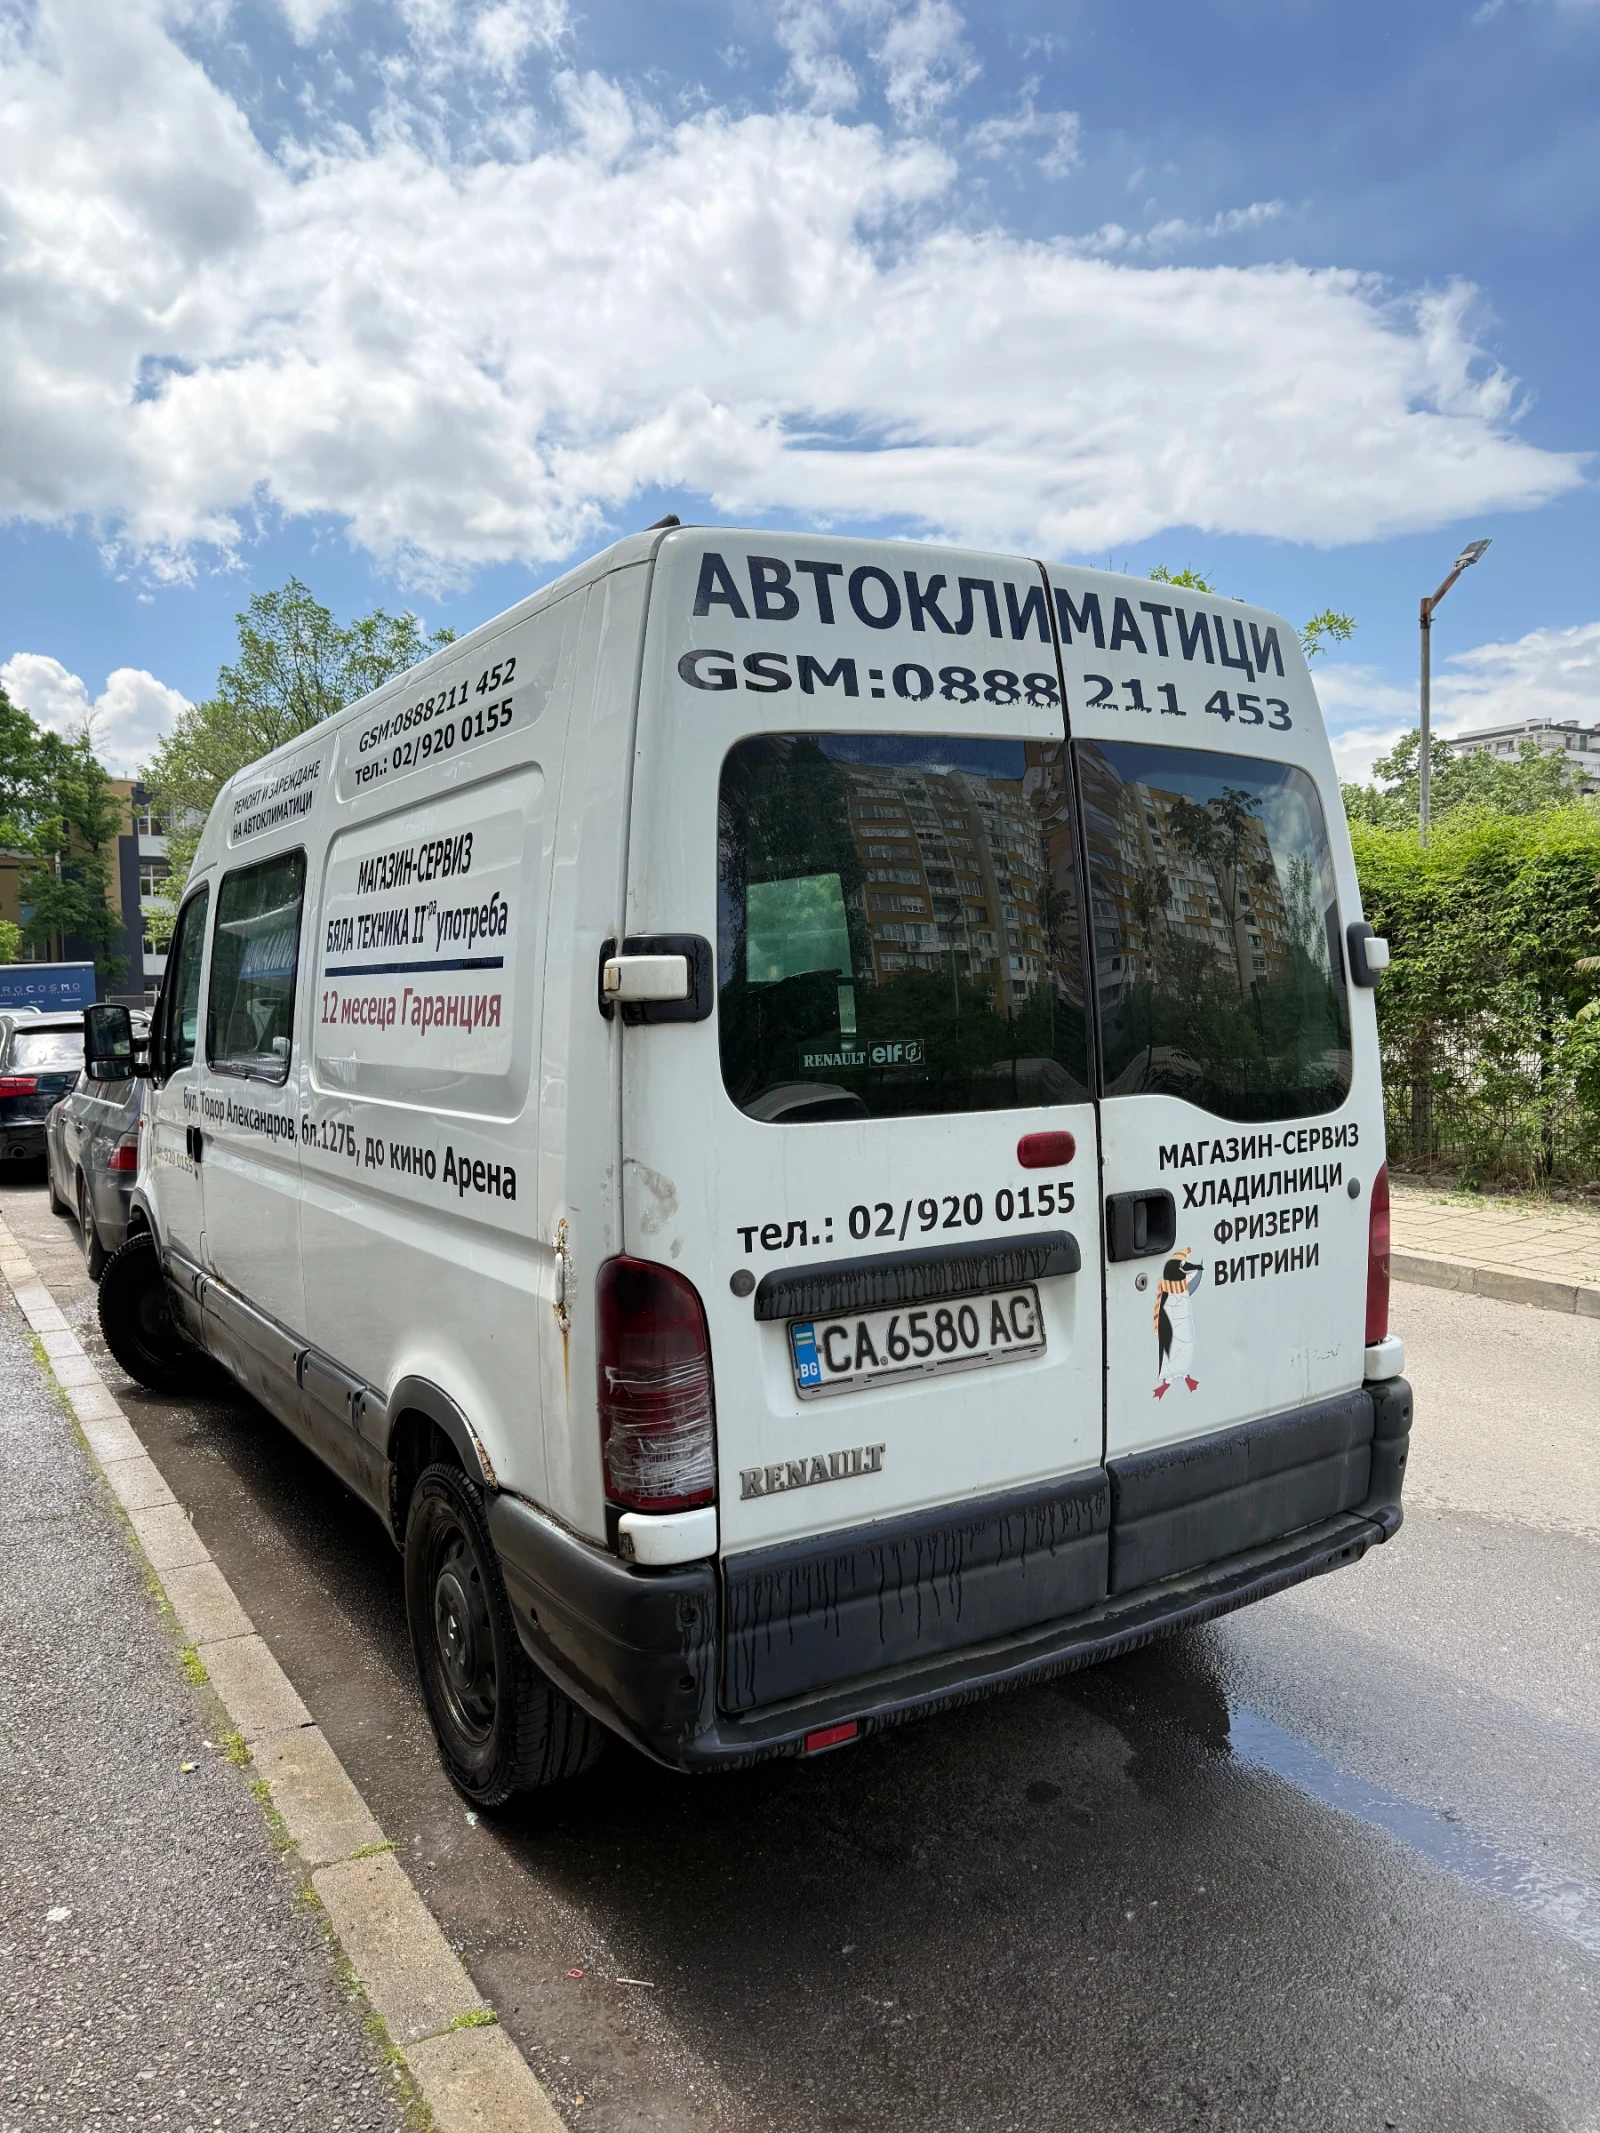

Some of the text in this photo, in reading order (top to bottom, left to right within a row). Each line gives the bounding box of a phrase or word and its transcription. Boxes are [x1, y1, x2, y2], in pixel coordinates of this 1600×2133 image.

[692, 552, 1285, 682] АВТОКЛИМАТИЦИ
[359, 657, 517, 752] GSM:0888211 452
[677, 649, 1294, 732] GSM:0888 211 453
[355, 697, 514, 785] тел.: 02/920 0155
[233, 760, 321, 816] РЕМОНТ И ЗАРЕЖДАНЕ
[233, 790, 313, 840] НА АВТОКЛИМАТИЦИ
[357, 832, 473, 895] МАГАЗИН-СЕРВИЗ
[326, 917, 354, 955] БЯЛА
[357, 907, 409, 950] ТЕХНИКА
[436, 891, 508, 952] употреба
[321, 988, 502, 1036] 12 месеца Гаранция
[804, 1044, 902, 1067] RENAULT elf
[200, 1091, 225, 1126] Тодор
[227, 1097, 298, 1147] Александров,
[301, 1114, 360, 1166] бл.127Б,
[365, 1137, 385, 1169] до
[389, 1142, 436, 1180] кино
[442, 1146, 517, 1201] Арена
[1159, 1123, 1359, 1170] МАГАЗИН-СЕРВИЗ
[1182, 1162, 1342, 1209] ХЛАДИЛНИЦИ
[737, 1181, 1075, 1253] тел.: 02/920 0155
[1213, 1204, 1319, 1244] ФРИЗЕРИ
[1214, 1243, 1319, 1286] ВИТРИНИ
[823, 1296, 1035, 1373] CA 6580 AC
[800, 1361, 818, 1378] BG
[740, 1443, 886, 1500] RENAULT
